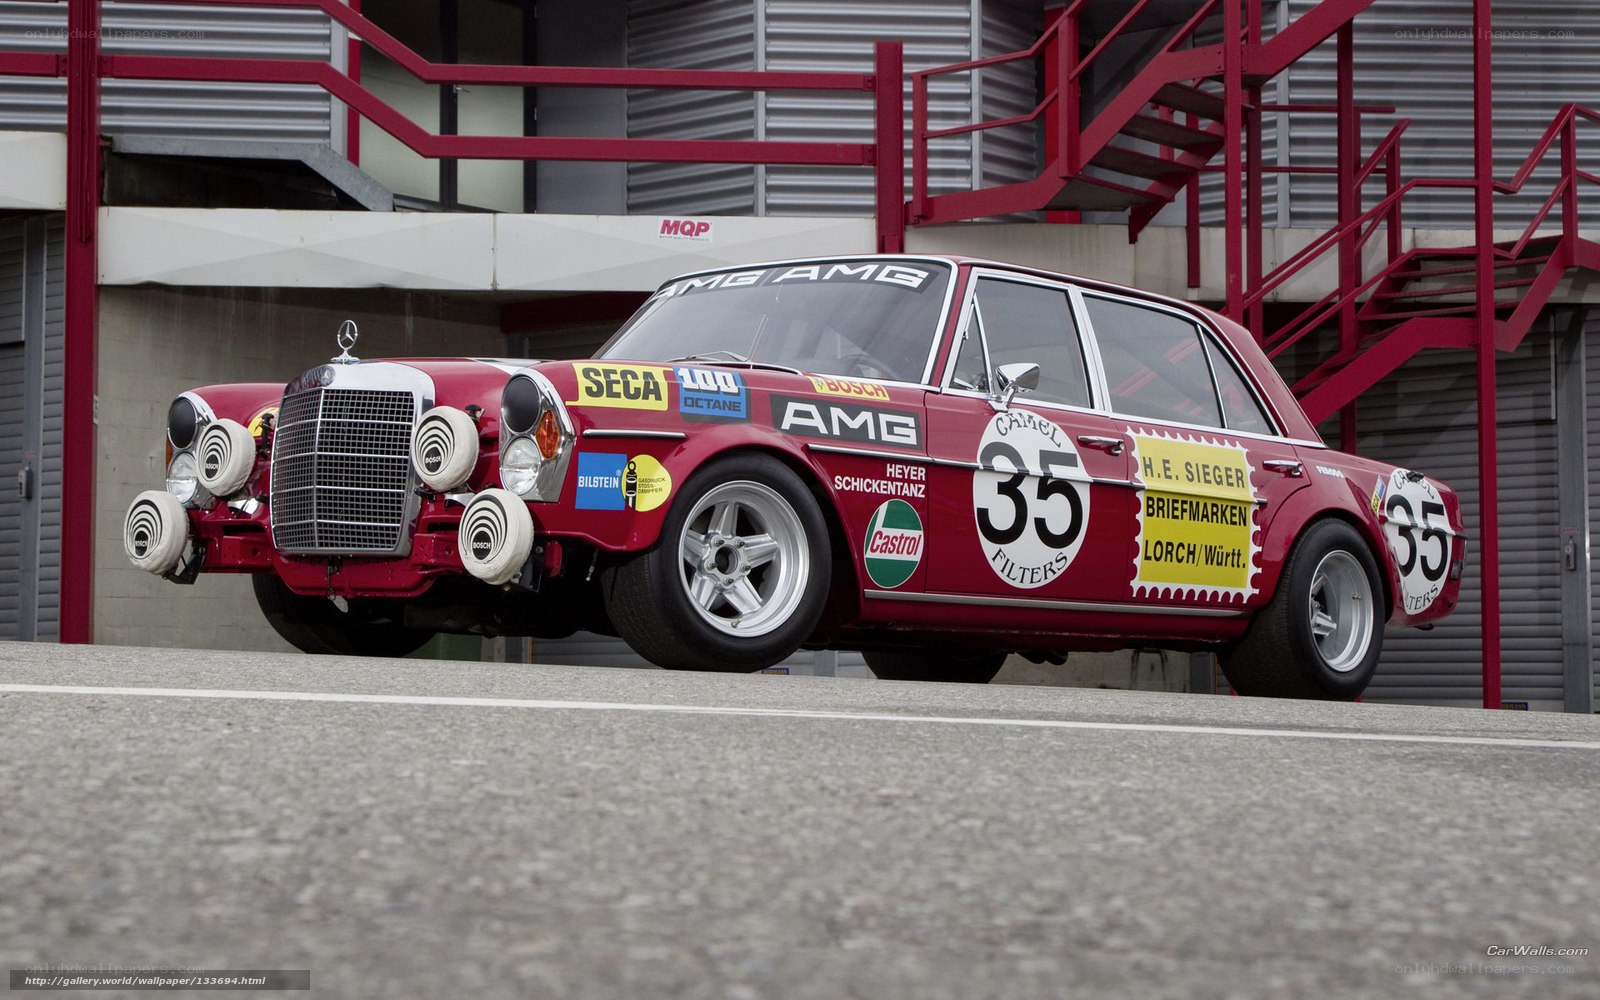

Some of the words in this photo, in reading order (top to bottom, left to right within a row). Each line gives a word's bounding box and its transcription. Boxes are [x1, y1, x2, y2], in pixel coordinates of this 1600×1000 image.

[660, 219, 710, 237] MQP
[648, 270, 766, 301] AMG
[772, 264, 930, 289] AMG
[582, 367, 662, 401] SECA
[678, 368, 740, 396] 100
[825, 377, 887, 398] BOSCH
[684, 396, 742, 412] OCTANE
[780, 401, 918, 446] AMG
[995, 412, 1062, 448] CAMEL
[425, 455, 441, 464] BOSCH
[886, 463, 926, 481] HEYER
[1142, 456, 1179, 481] H.E.
[1184, 461, 1245, 489] SIEGER
[578, 475, 619, 489] BILSTEIN
[834, 475, 926, 498] SCHICKENTANZ
[976, 441, 1083, 549] 35
[1146, 496, 1247, 527] BRIEFMARKEN
[472, 541, 491, 549] BOSCH
[869, 530, 922, 556] Castrol
[1387, 494, 1448, 582] 35
[992, 547, 1069, 585] FILTERS
[1144, 539, 1246, 569] LORCH/Württ.
